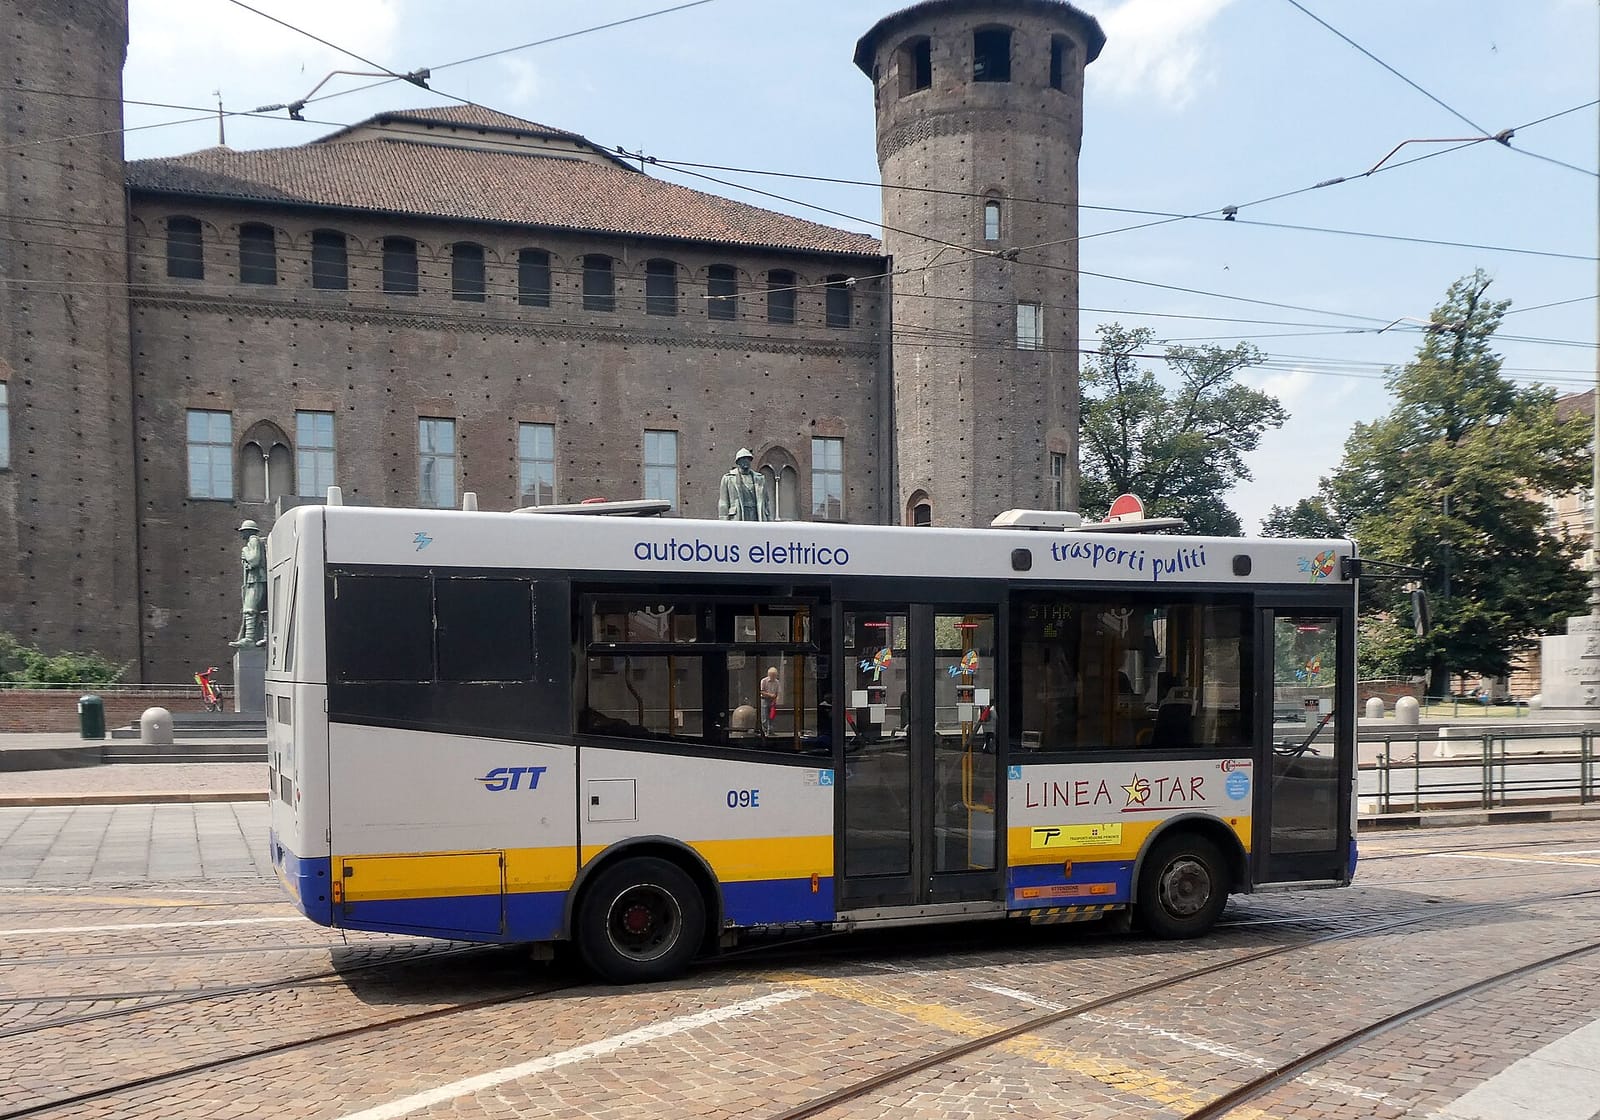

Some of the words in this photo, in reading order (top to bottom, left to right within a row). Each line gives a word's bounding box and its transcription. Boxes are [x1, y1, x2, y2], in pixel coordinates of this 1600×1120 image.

[634, 538, 740, 563] autobus
[749, 541, 849, 565] elettrico
[1051, 542, 1145, 571] trasporti
[1152, 545, 1206, 581] puliti
[476, 766, 547, 792] GTT
[1026, 779, 1112, 808] LINEA
[1132, 776, 1206, 804] STAR
[727, 789, 760, 808] 09E
